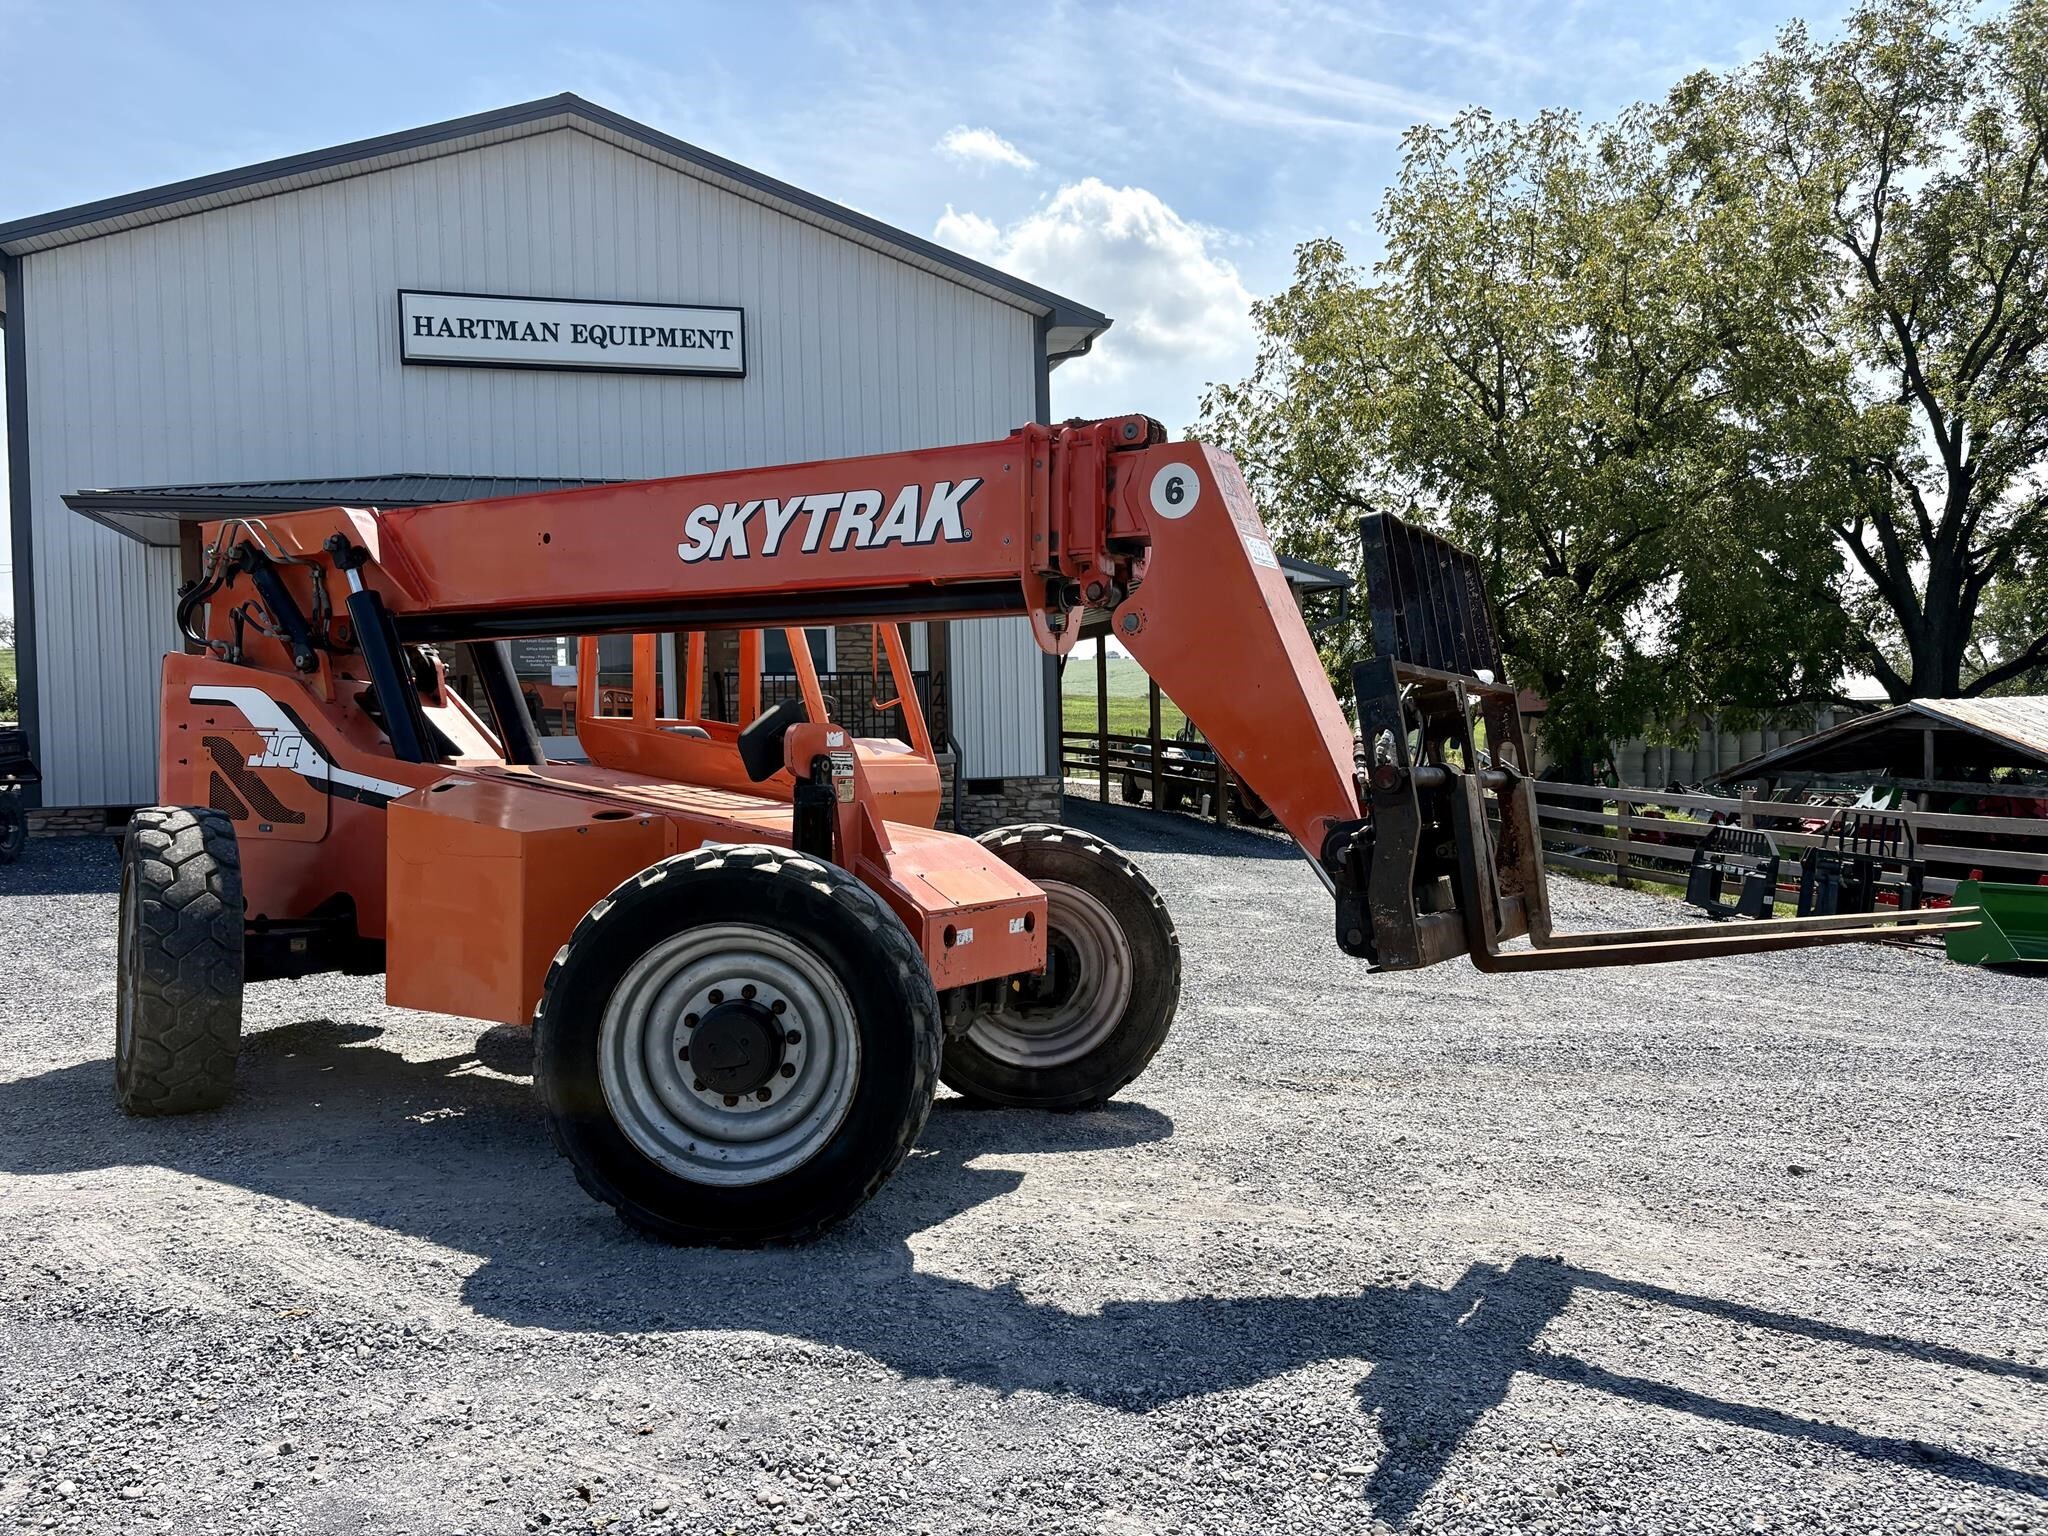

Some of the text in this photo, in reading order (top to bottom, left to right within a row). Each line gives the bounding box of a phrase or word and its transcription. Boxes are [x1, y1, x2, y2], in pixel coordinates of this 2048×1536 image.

[412, 315, 734, 350] HARTMAN EQUIPMENT
[1164, 476, 1185, 505] 6
[678, 477, 984, 563] SKYTRAK
